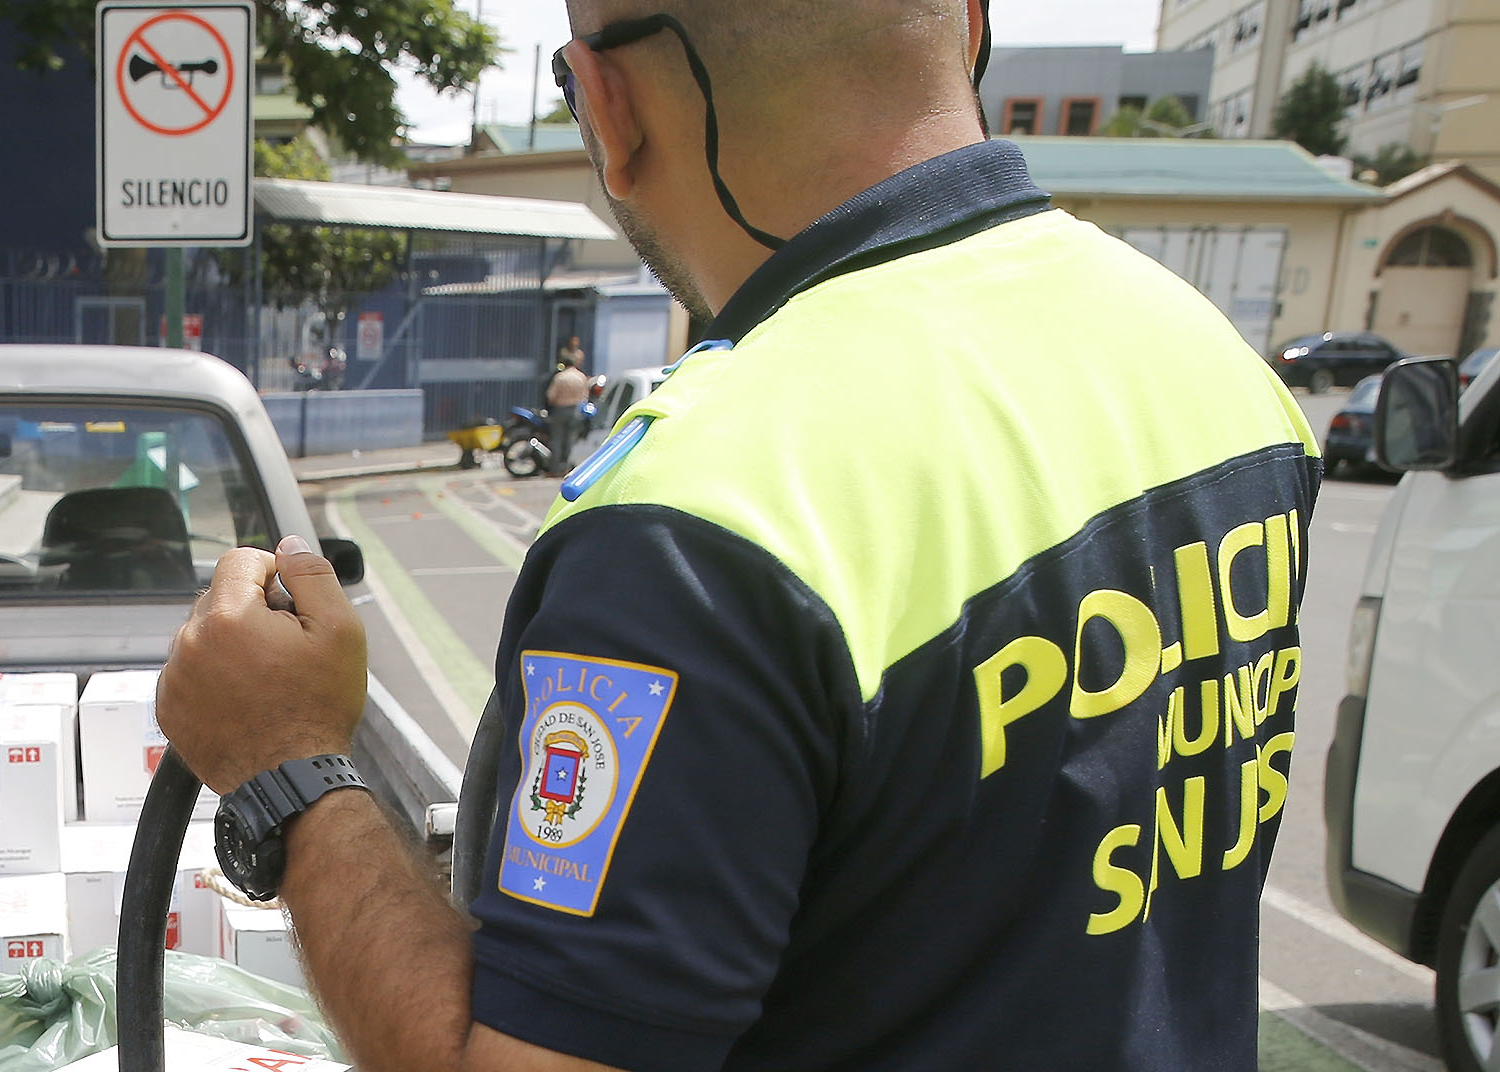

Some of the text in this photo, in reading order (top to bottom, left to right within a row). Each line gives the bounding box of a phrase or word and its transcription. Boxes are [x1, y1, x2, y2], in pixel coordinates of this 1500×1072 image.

[122, 180, 228, 206] SILENCIO
[590, 738, 606, 770] JOSE
[536, 825, 564, 842] 1989
